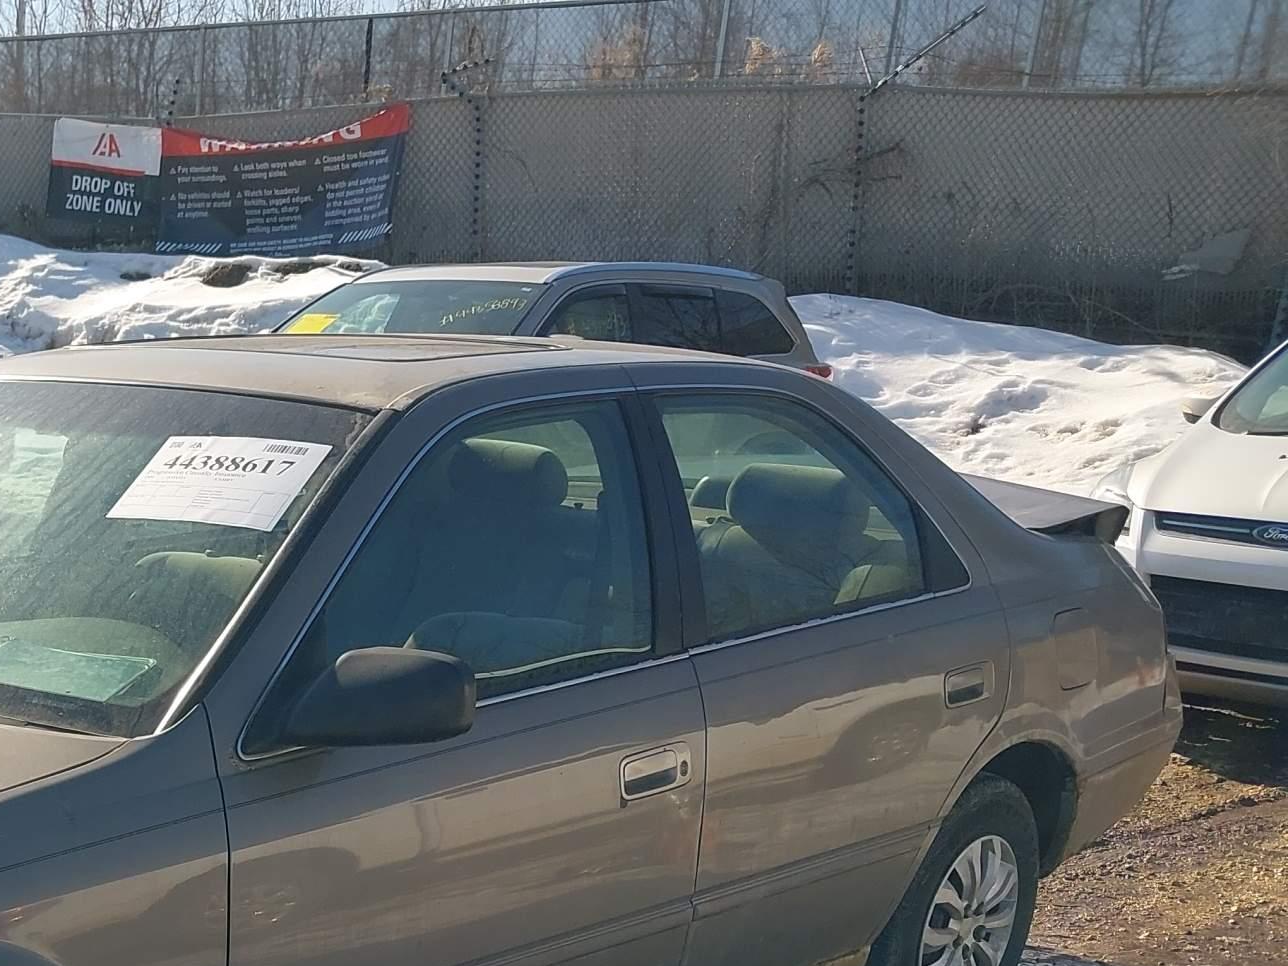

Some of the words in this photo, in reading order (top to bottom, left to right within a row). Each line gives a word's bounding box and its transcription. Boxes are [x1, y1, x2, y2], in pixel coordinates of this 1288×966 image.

[72, 175, 111, 193] DROP
[114, 180, 135, 197] OFF
[65, 194, 101, 212] ZONE
[104, 198, 142, 217] ONLY
[163, 454, 297, 476] 44388617
